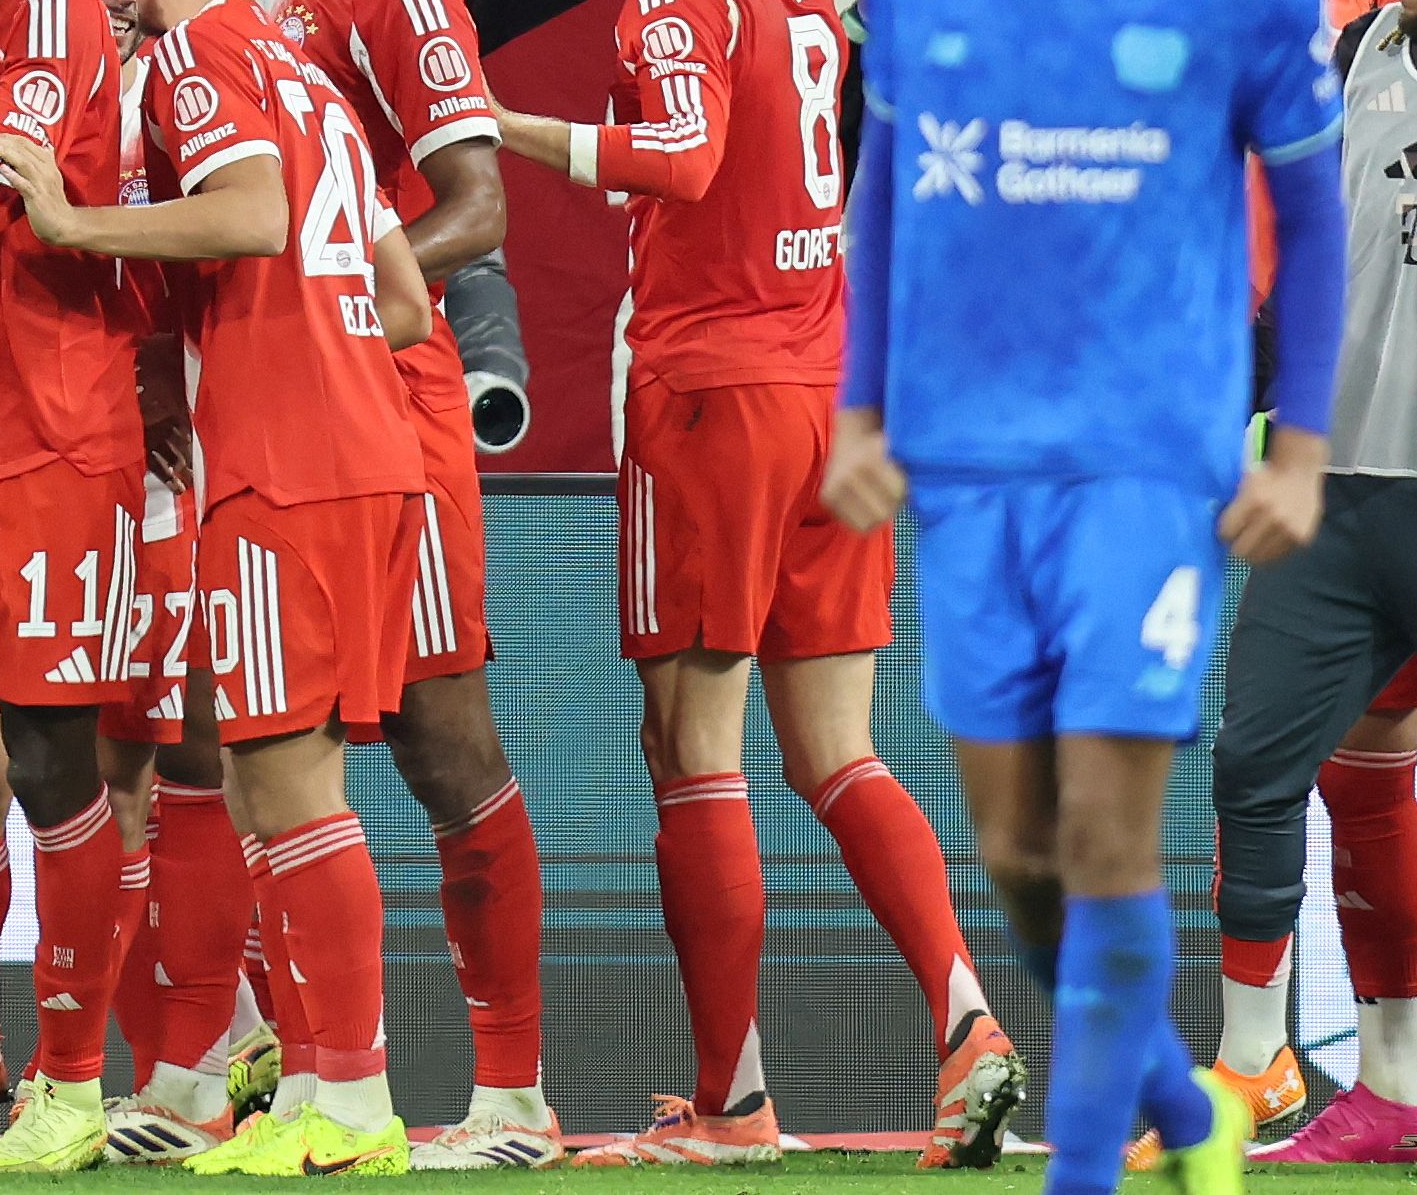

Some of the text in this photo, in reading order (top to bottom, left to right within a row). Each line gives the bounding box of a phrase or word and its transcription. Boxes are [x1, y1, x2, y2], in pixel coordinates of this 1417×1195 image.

[3, 111, 53, 147] Allia
[428, 95, 488, 123] Allianz
[787, 13, 840, 209] 8
[180, 121, 238, 162] Allianz
[775, 223, 846, 272] GORET
[338, 294, 385, 337] BIS
[18, 549, 104, 638] 11
[1140, 565, 1201, 669] 4
